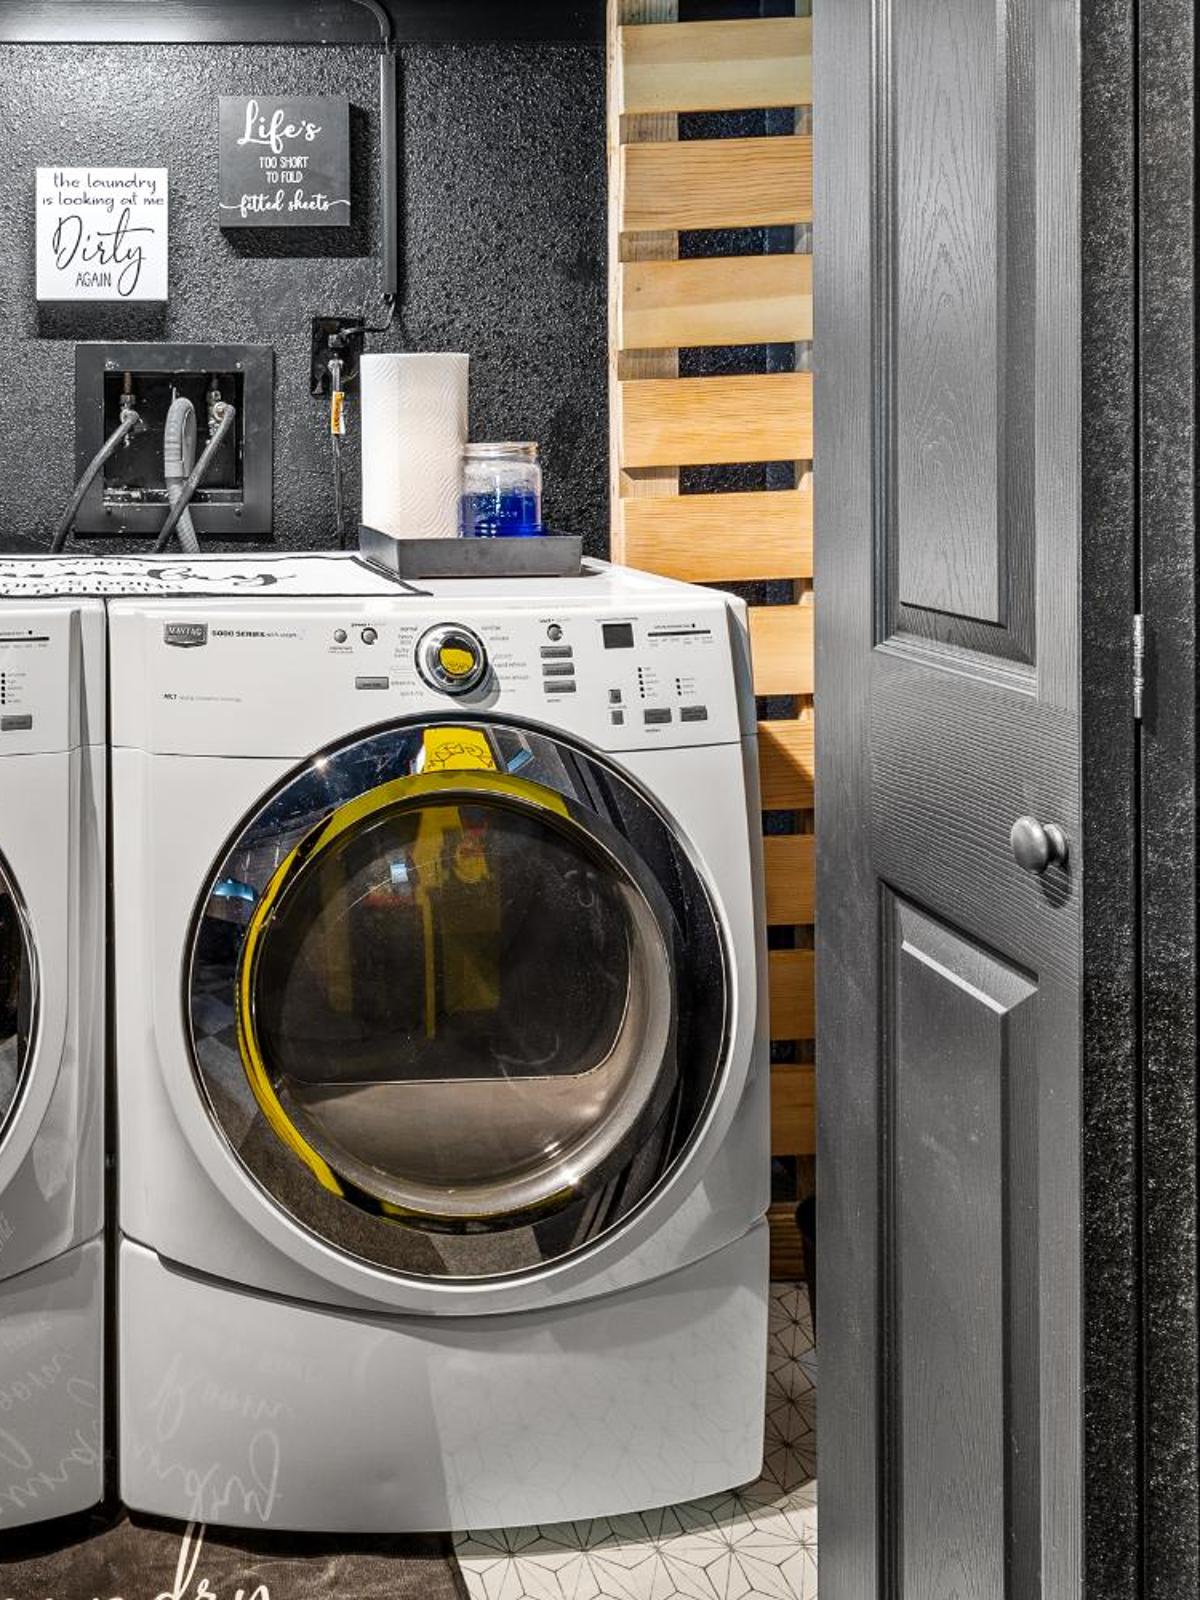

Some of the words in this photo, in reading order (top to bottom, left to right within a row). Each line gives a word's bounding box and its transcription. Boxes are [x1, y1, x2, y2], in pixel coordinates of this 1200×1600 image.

[237, 100, 322, 154] Life's
[259, 157, 276, 168] TOO
[280, 156, 309, 168] SHORT
[53, 172, 80, 188] the
[87, 172, 157, 194] laundry
[266, 171, 278, 184] TO
[281, 171, 303, 184] FOLD
[42, 196, 53, 206] is
[58, 192, 114, 213] looking
[120, 194, 138, 206] at
[143, 197, 164, 206] me
[221, 189, 285, 218] fitted
[288, 189, 348, 212] sheets
[52, 207, 155, 297] Dirty
[75, 272, 112, 287] AGAIN
